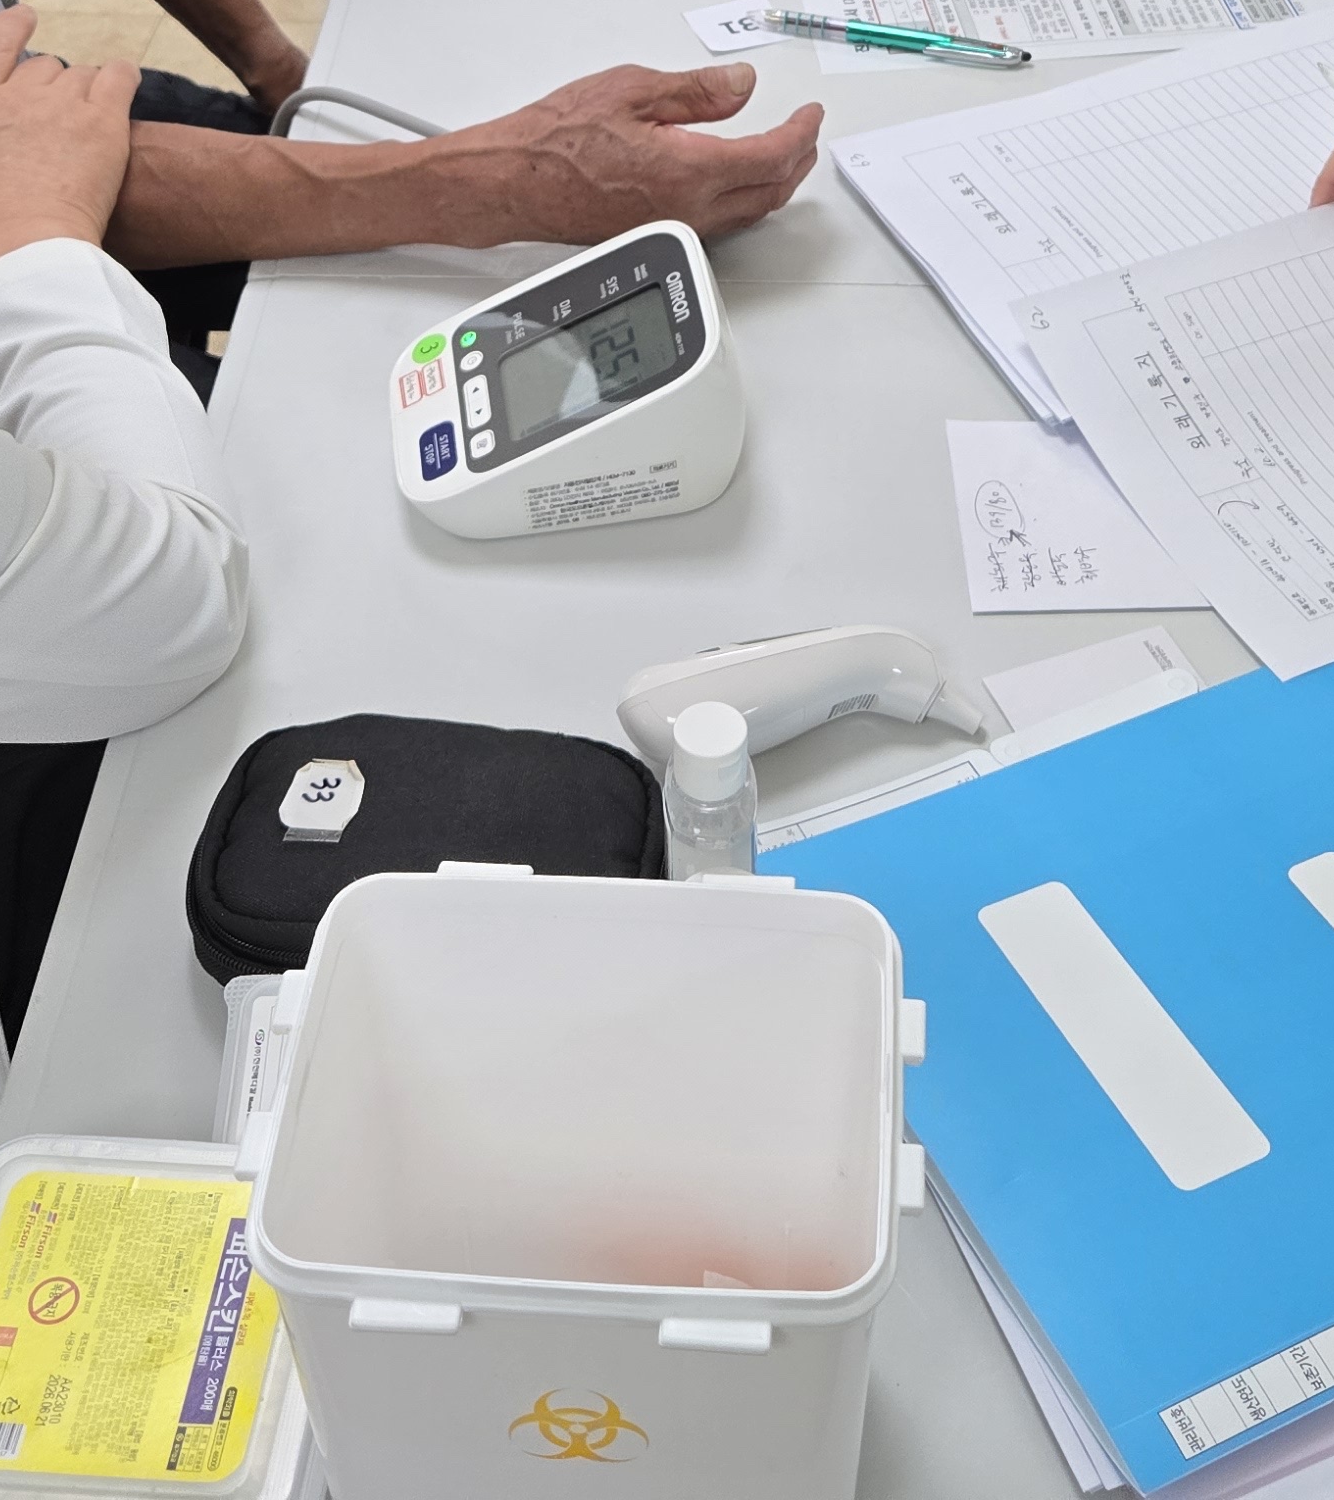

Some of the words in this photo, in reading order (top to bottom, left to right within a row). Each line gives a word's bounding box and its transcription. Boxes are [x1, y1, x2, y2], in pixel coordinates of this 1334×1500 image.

[718, 16, 759, 34] 31
[846, 148, 871, 174] 63
[1080, 235, 1103, 259] Progress
[606, 276, 619, 294] SYS
[666, 272, 690, 323] OMRON
[558, 299, 572, 317] DIA
[1022, 304, 1052, 335] 62
[511, 311, 525, 339] PULSE
[420, 344, 437, 354] 3
[1245, 409, 1275, 444] treatment
[423, 443, 436, 464] STOP
[437, 434, 451, 460] START
[1281, 455, 1308, 486] Progress
[301, 777, 342, 803] 33
[18, 1213, 36, 1248] Firson
[36, 1225, 53, 1258] Firson
[209, 1231, 253, 1336] 퍼슨스킨
[59, 1330, 76, 1363] 사용기한
[73, 1330, 89, 1363] 제조번호
[208, 1334, 229, 1373] 플러스
[1289, 1346, 1326, 1390] 보존기간
[33, 1372, 59, 1429] 2026.06.21
[48, 1375, 72, 1426] AA23010
[199, 1376, 219, 1412] 200매
[1231, 1375, 1267, 1421] 생산연도
[1170, 1404, 1206, 1452] 관리번호
